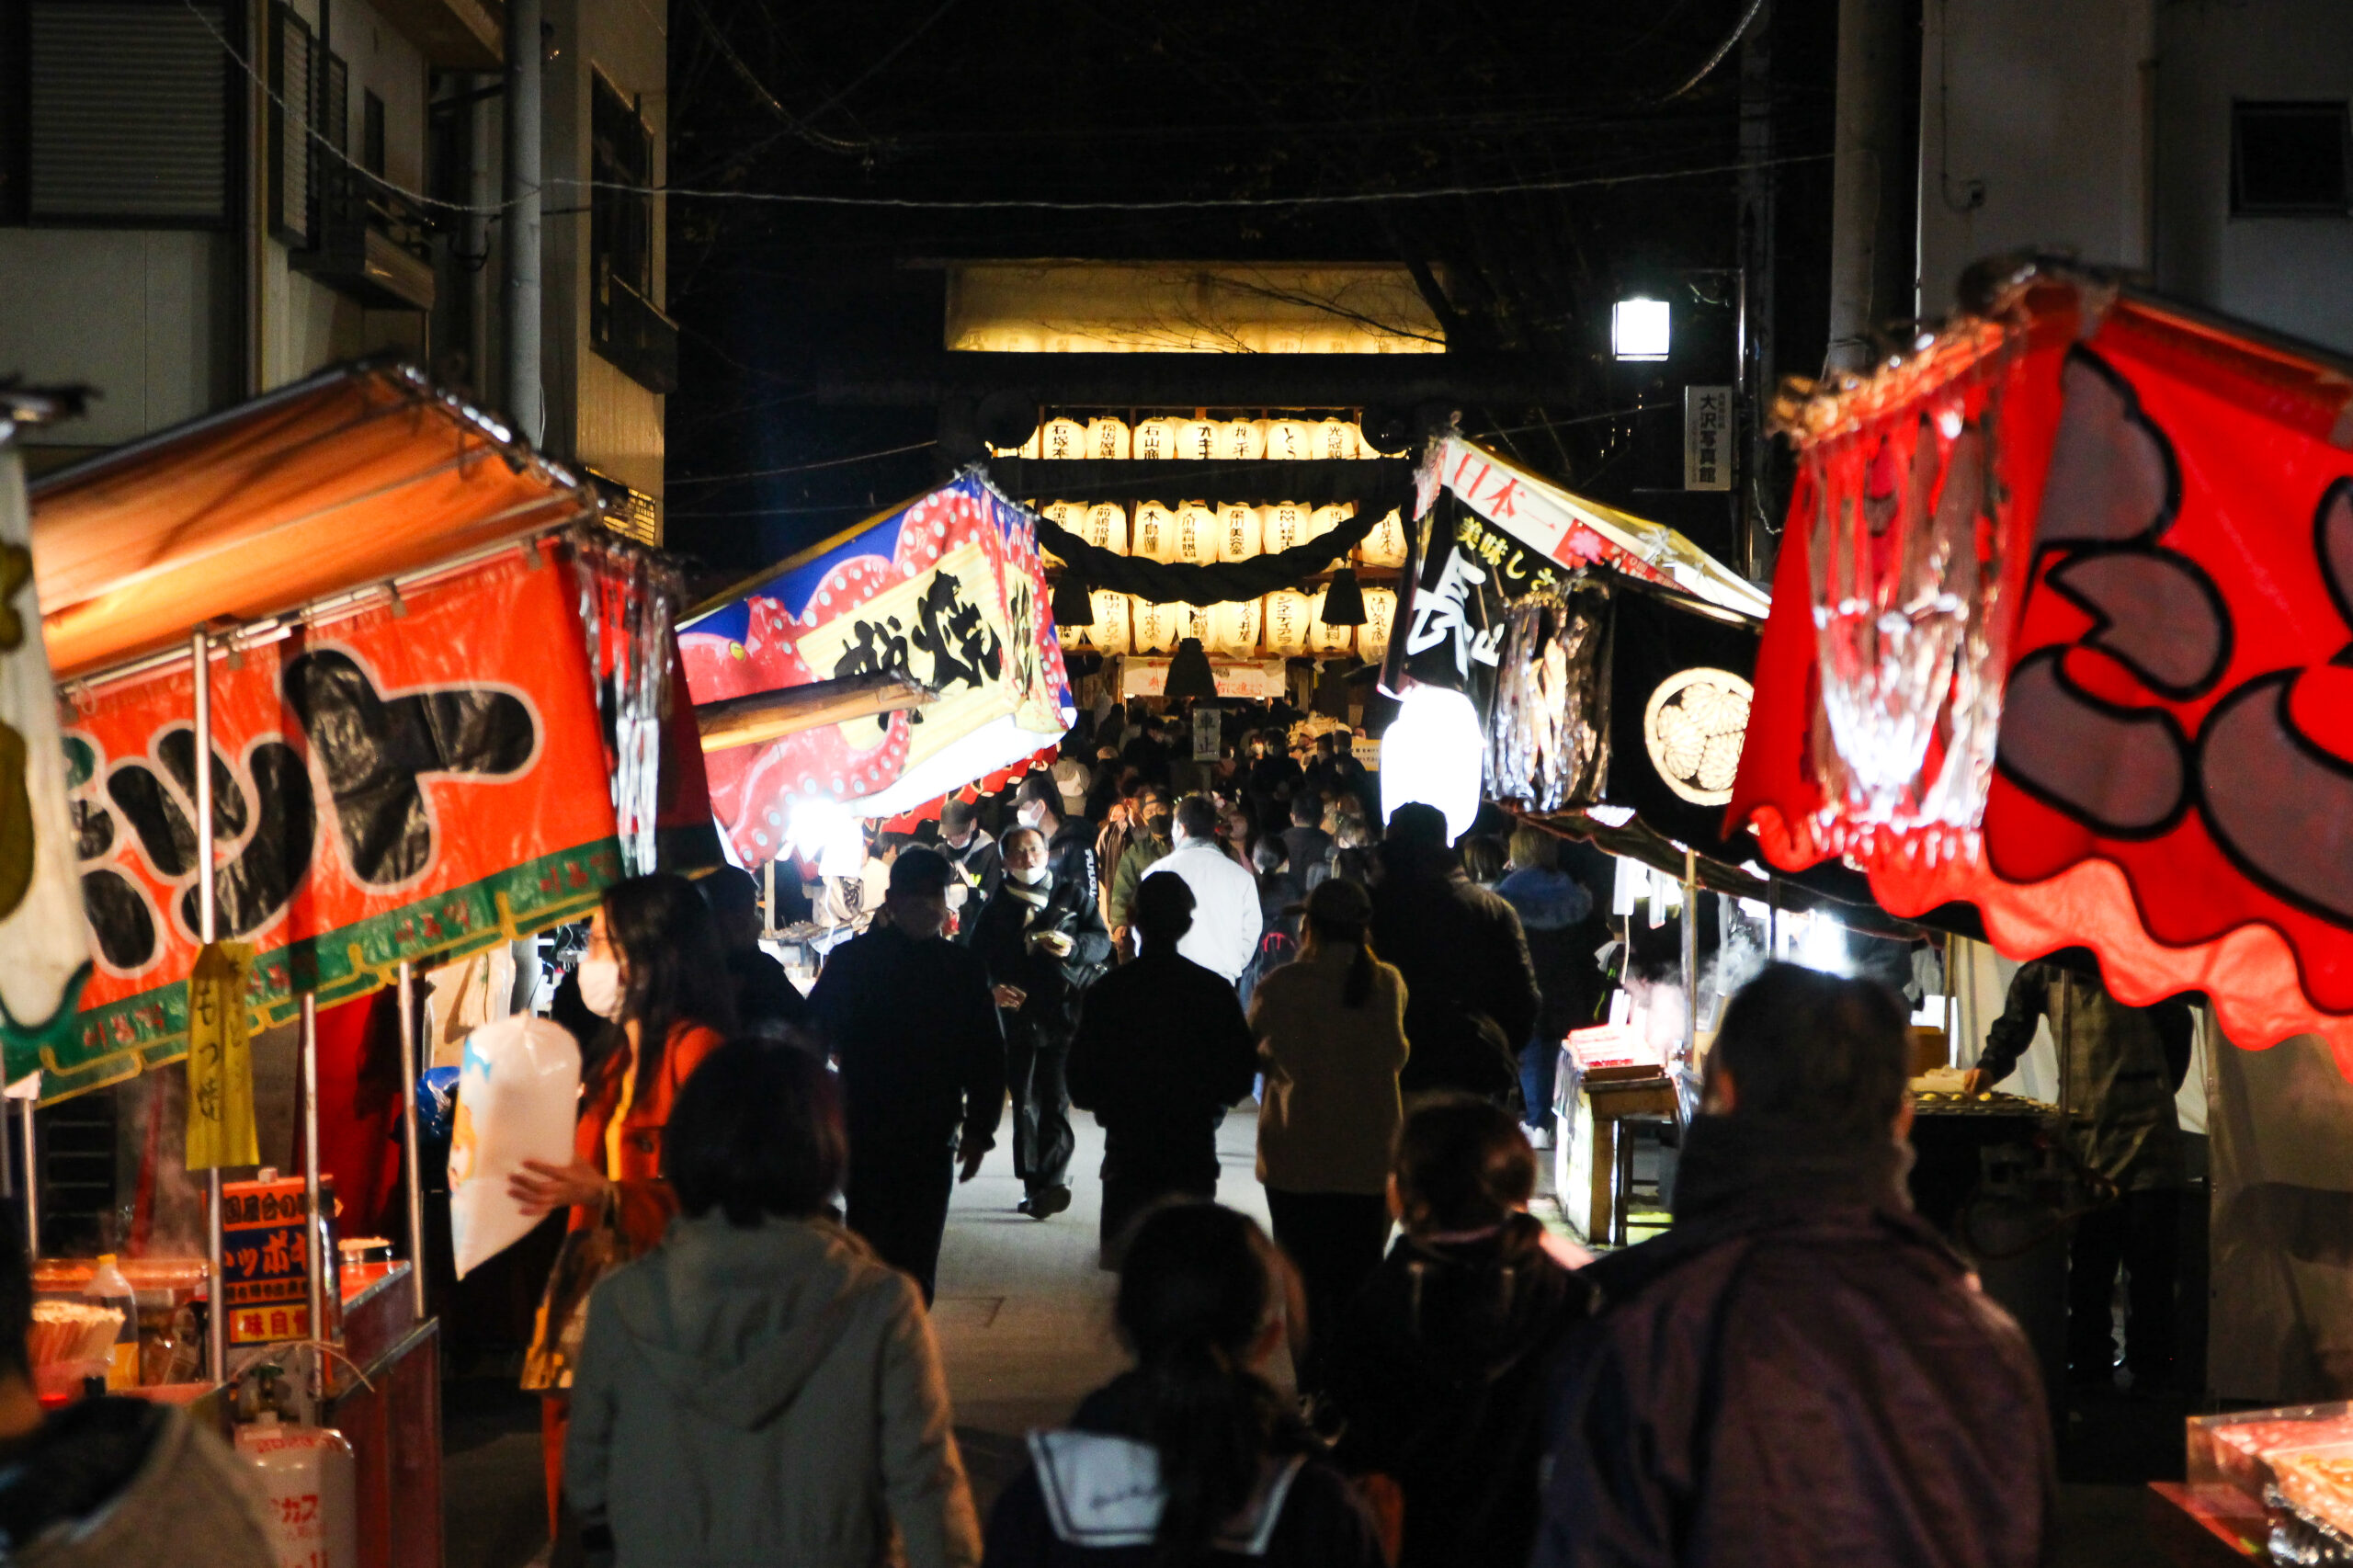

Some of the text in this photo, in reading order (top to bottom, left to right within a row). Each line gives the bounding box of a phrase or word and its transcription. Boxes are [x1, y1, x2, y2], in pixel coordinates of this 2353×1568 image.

[1699, 392, 1717, 484] 大沢写真館
[1452, 452, 1557, 531] 日本一
